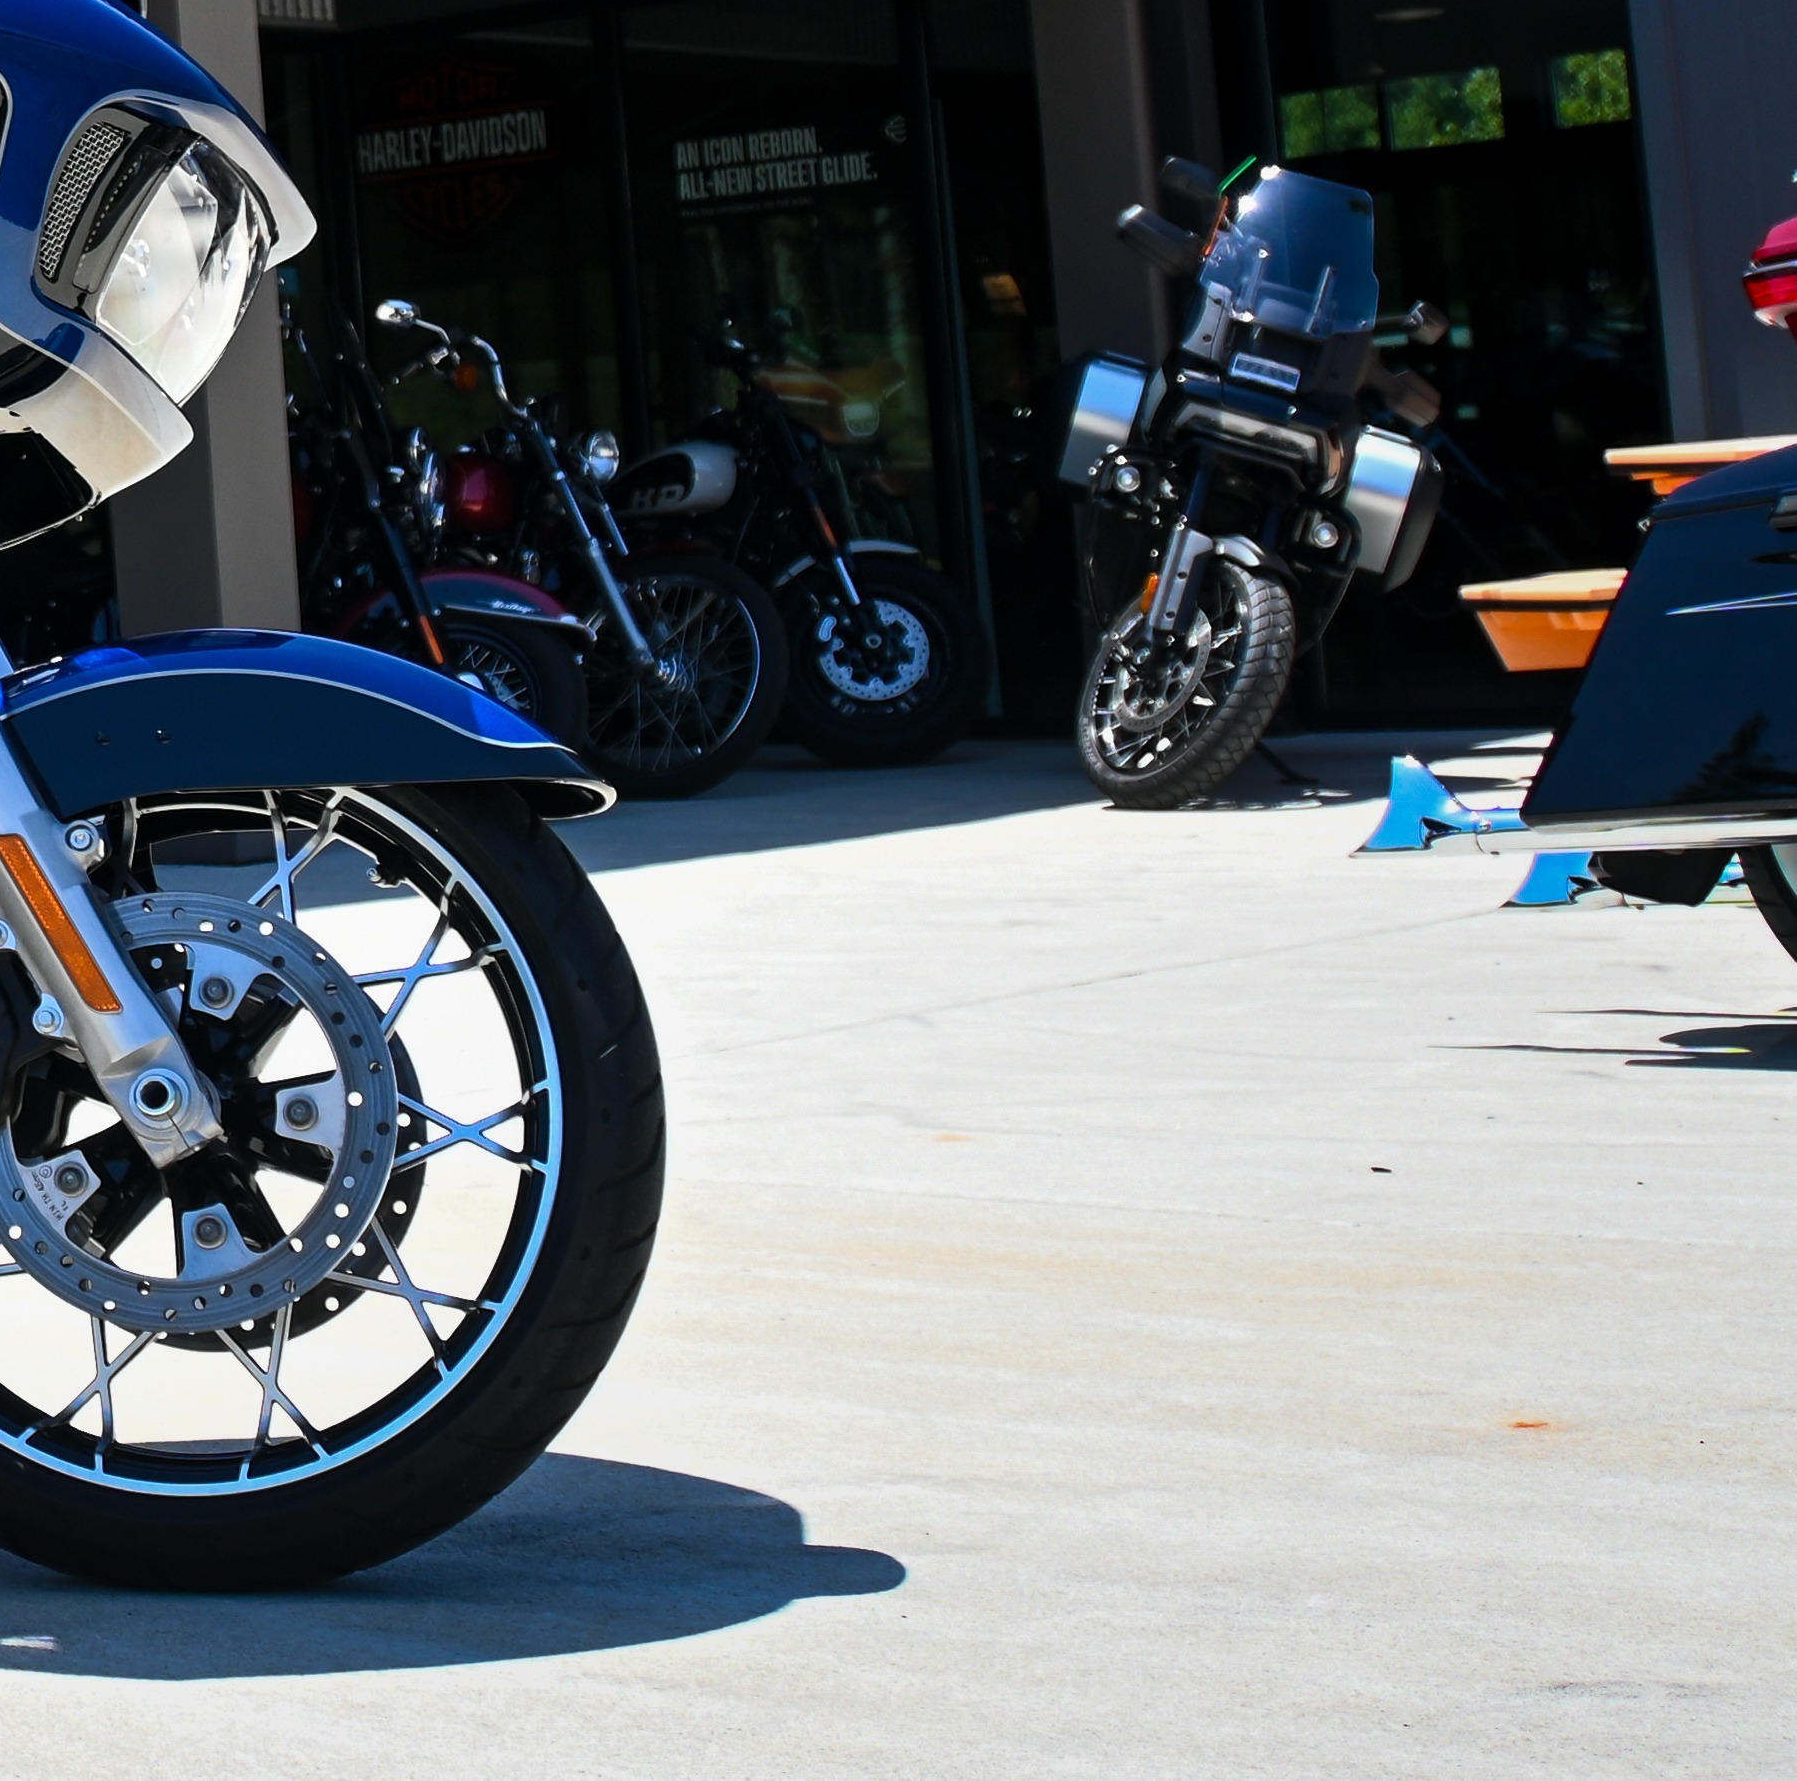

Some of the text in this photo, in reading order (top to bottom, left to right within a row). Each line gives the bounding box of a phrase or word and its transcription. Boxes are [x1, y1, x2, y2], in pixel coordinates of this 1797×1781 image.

[358, 109, 548, 173] HARLEY-DAVIDSON
[677, 126, 823, 168] AN ICON REBORN.
[679, 151, 879, 201] ALL-NEW STREET GLIDE.
